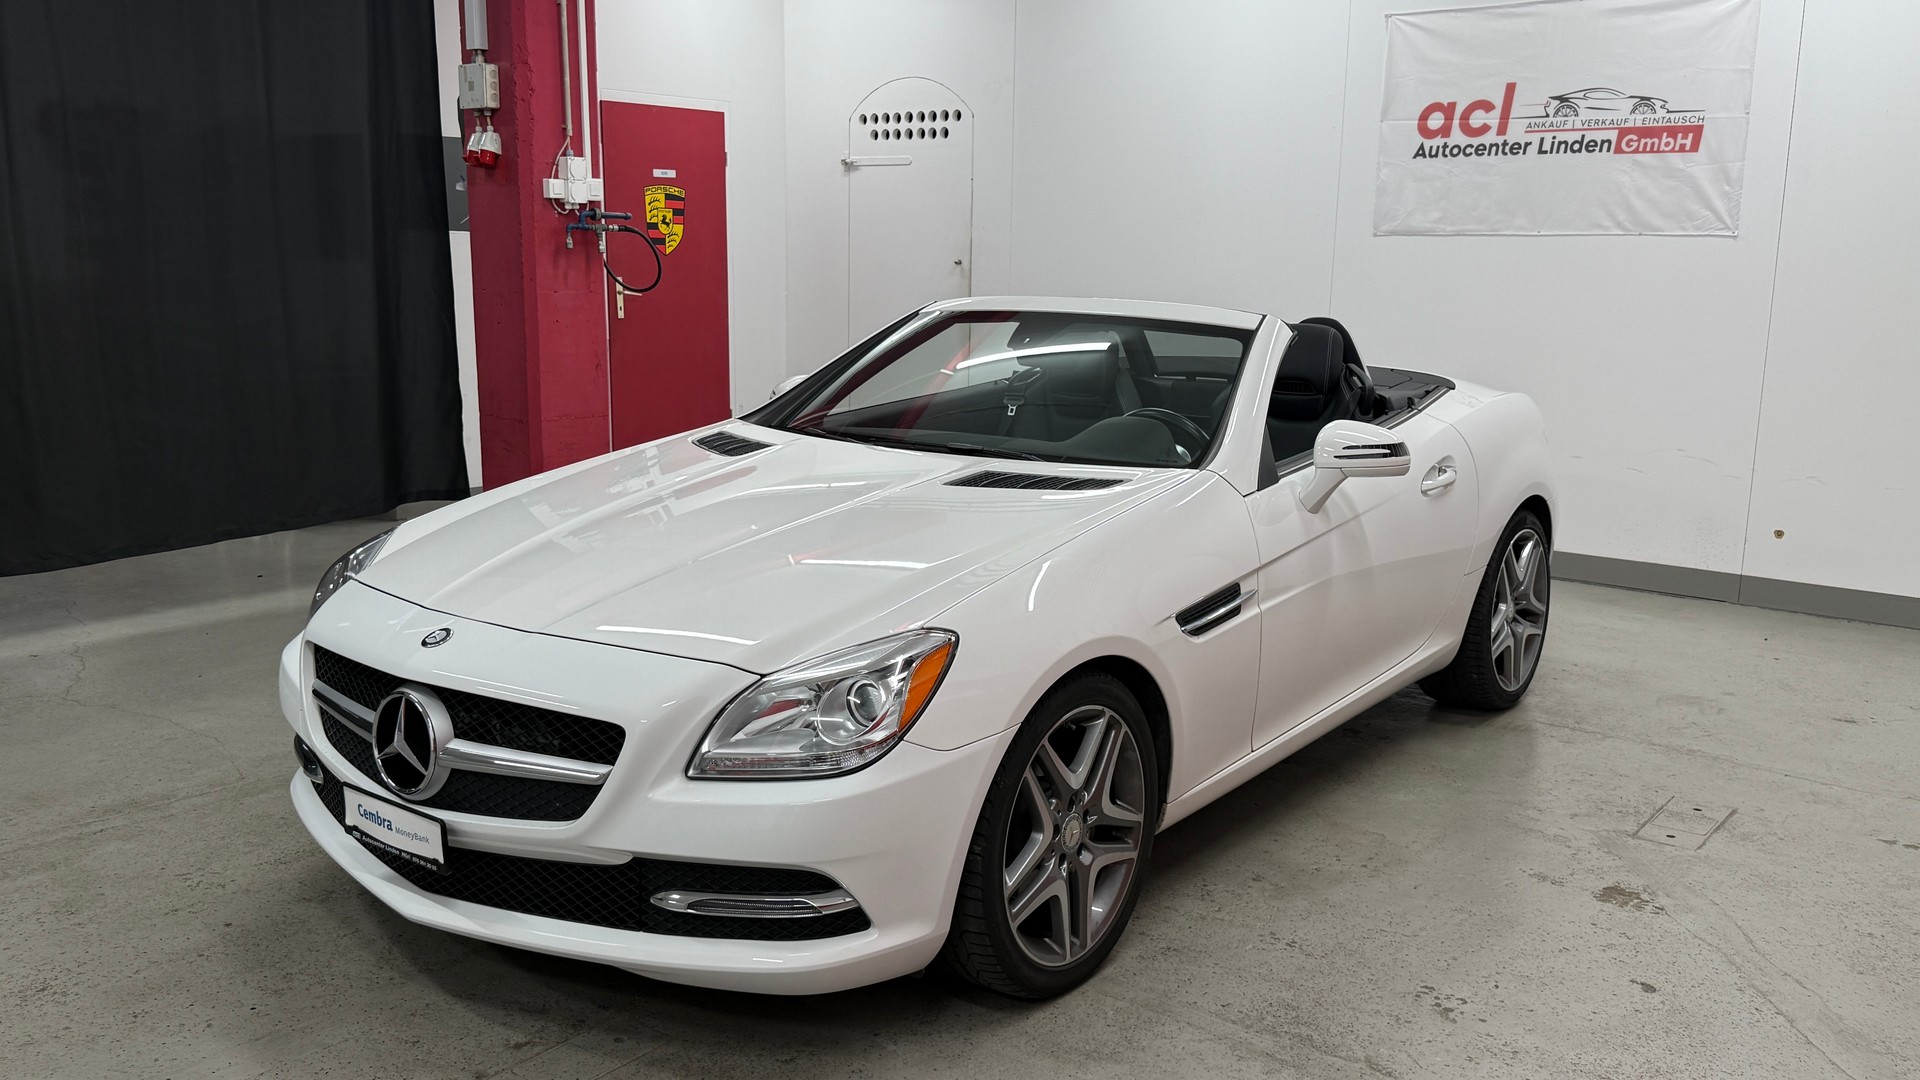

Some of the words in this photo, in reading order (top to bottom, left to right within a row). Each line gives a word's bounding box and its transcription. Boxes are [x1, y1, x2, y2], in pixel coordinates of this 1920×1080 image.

[1416, 82, 1517, 140] acl
[1525, 119, 1569, 130] ANKAUF
[1580, 117, 1630, 128] VERKAUF
[1641, 115, 1706, 126] EINTAUSCH
[1412, 138, 1532, 160] Autocenter
[1537, 134, 1613, 156] Linden
[1620, 132, 1694, 153] GmbH
[646, 186, 685, 196] PORSCHE
[357, 803, 393, 832] Cembra
[395, 826, 430, 844] MoneyBank
